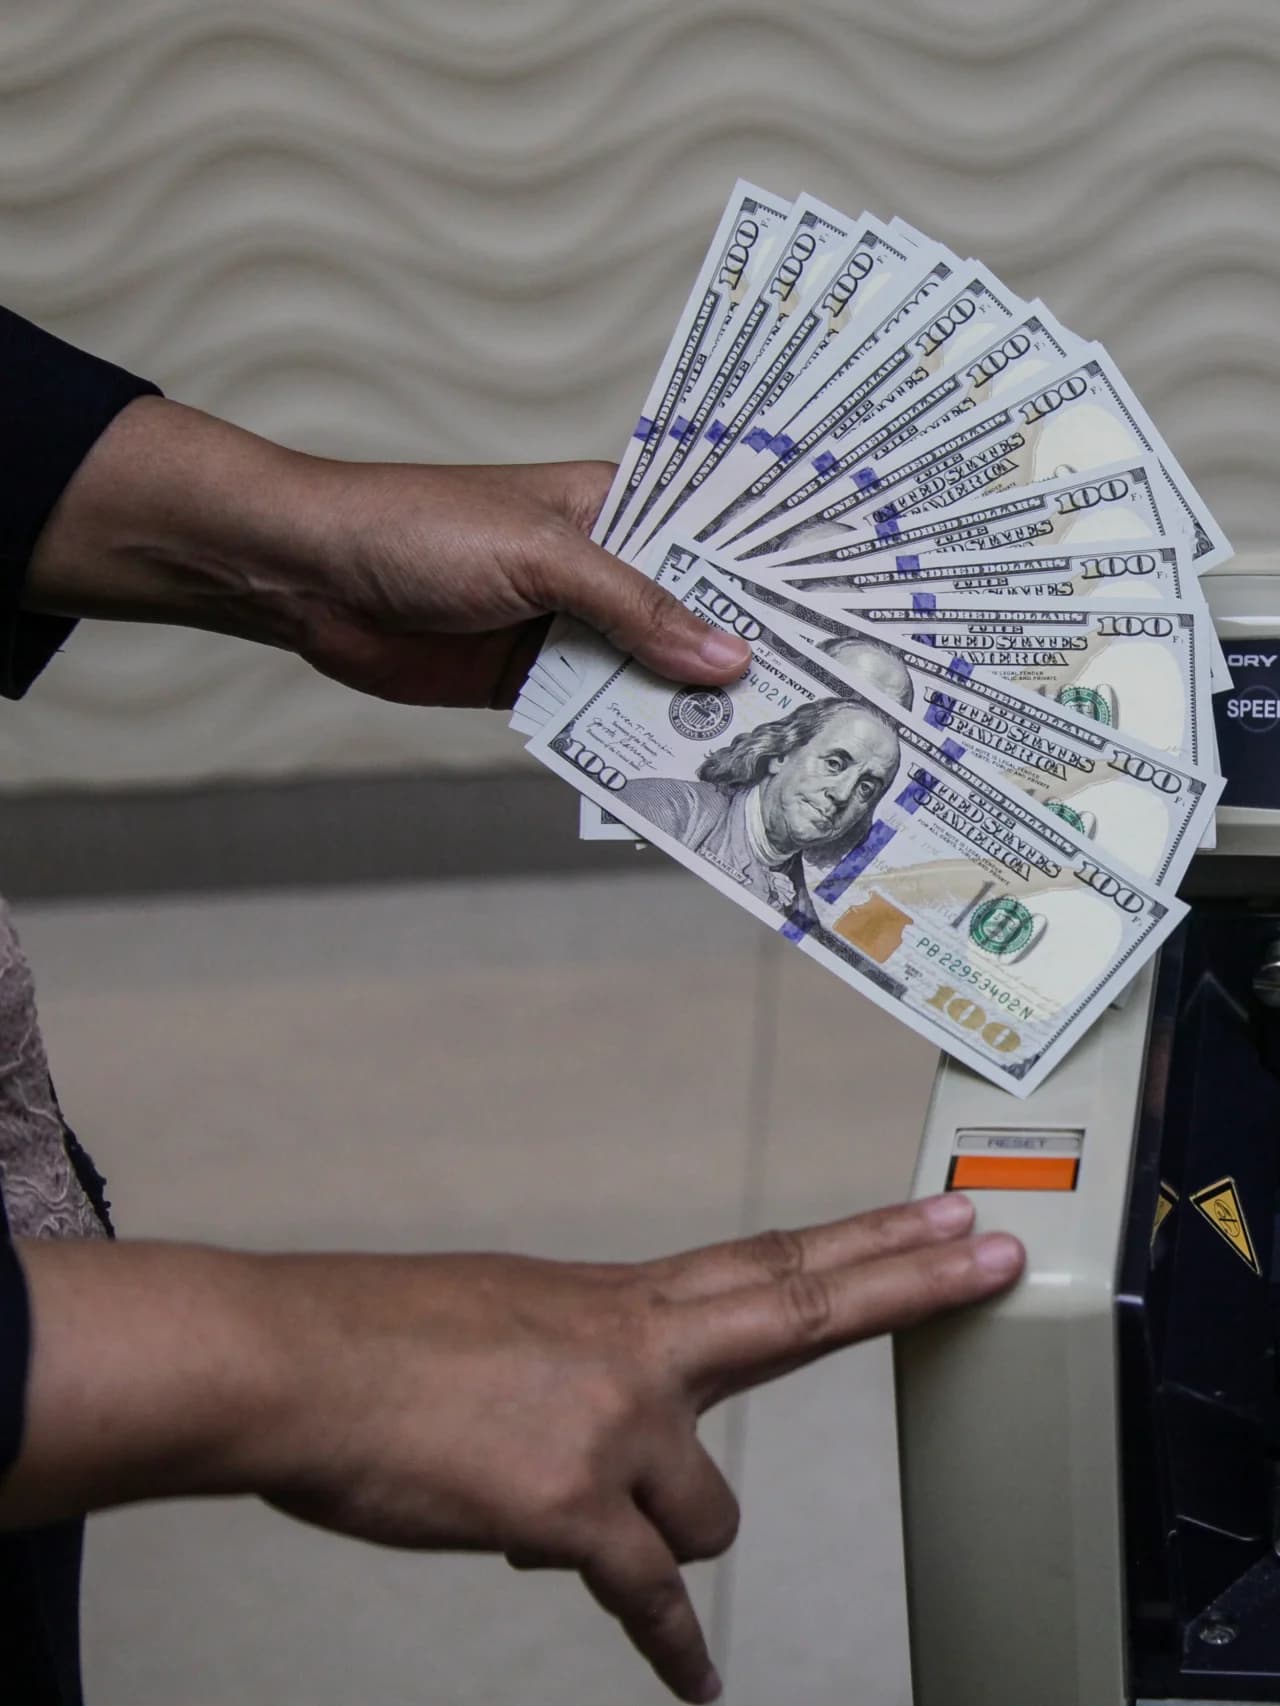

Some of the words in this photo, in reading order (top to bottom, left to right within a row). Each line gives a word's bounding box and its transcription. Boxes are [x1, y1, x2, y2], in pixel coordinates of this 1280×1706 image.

[719, 219, 759, 290] 100
[770, 233, 817, 301] 100
[822, 252, 874, 317] 100
[916, 298, 976, 356] 100
[966, 334, 1030, 388] 100
[751, 466, 780, 495] ONE
[778, 405, 847, 474] HUNDRED
[844, 352, 906, 411] DOLLARS
[1019, 376, 1087, 425] 100
[787, 481, 819, 508] ONE
[817, 428, 890, 489] HUNDRED
[887, 379, 958, 436] DOLLARS
[822, 493, 857, 520] ONE
[855, 453, 934, 501] HUNDRED
[931, 414, 1008, 462] DOLLARS
[943, 432, 1026, 486] STATES
[1054, 478, 1129, 515] 100
[836, 540, 873, 560] ONE
[872, 520, 960, 548] HUNDRED
[959, 498, 1042, 529] DOLLARS
[853, 571, 891, 586] ONE
[891, 564, 980, 583] HUNDRED
[982, 557, 1065, 574] DOLLARS
[953, 577, 1009, 589] THE
[1080, 553, 1156, 579] 100
[695, 588, 762, 641] 100
[868, 610, 905, 619] ONE
[907, 609, 996, 620] HUNDRED
[999, 611, 1083, 621] DOLLARS
[967, 624, 1024, 634] THE
[1097, 616, 1173, 637] 100
[911, 633, 995, 649] NITED
[995, 635, 1088, 651] STATES
[958, 651, 1069, 666] AMERICA
[1228, 654, 1277, 667] ORY
[752, 653, 786, 682] SERVE
[784, 677, 816, 702] NOTE
[903, 653, 941, 674] ONE
[940, 666, 1022, 708] HUNDRED
[1022, 704, 1102, 744] DOLLARS
[923, 686, 1008, 734] UNITED
[1009, 726, 1095, 773] STATES
[989, 703, 1042, 734] THE
[560, 738, 627, 791] 100
[964, 726, 1067, 781] AMERICA
[1107, 750, 1182, 794] 100
[899, 727, 931, 751] ONE
[930, 748, 1002, 800] HUNDRED
[1001, 797, 1075, 853] DOLLARS
[968, 790, 1017, 830] THE
[907, 762, 985, 823] UNITED
[981, 815, 1061, 878] STATES
[913, 786, 944, 815] OF
[936, 805, 1031, 882] AMERICA
[1073, 859, 1145, 913] 100
[926, 984, 1021, 1053] 100
